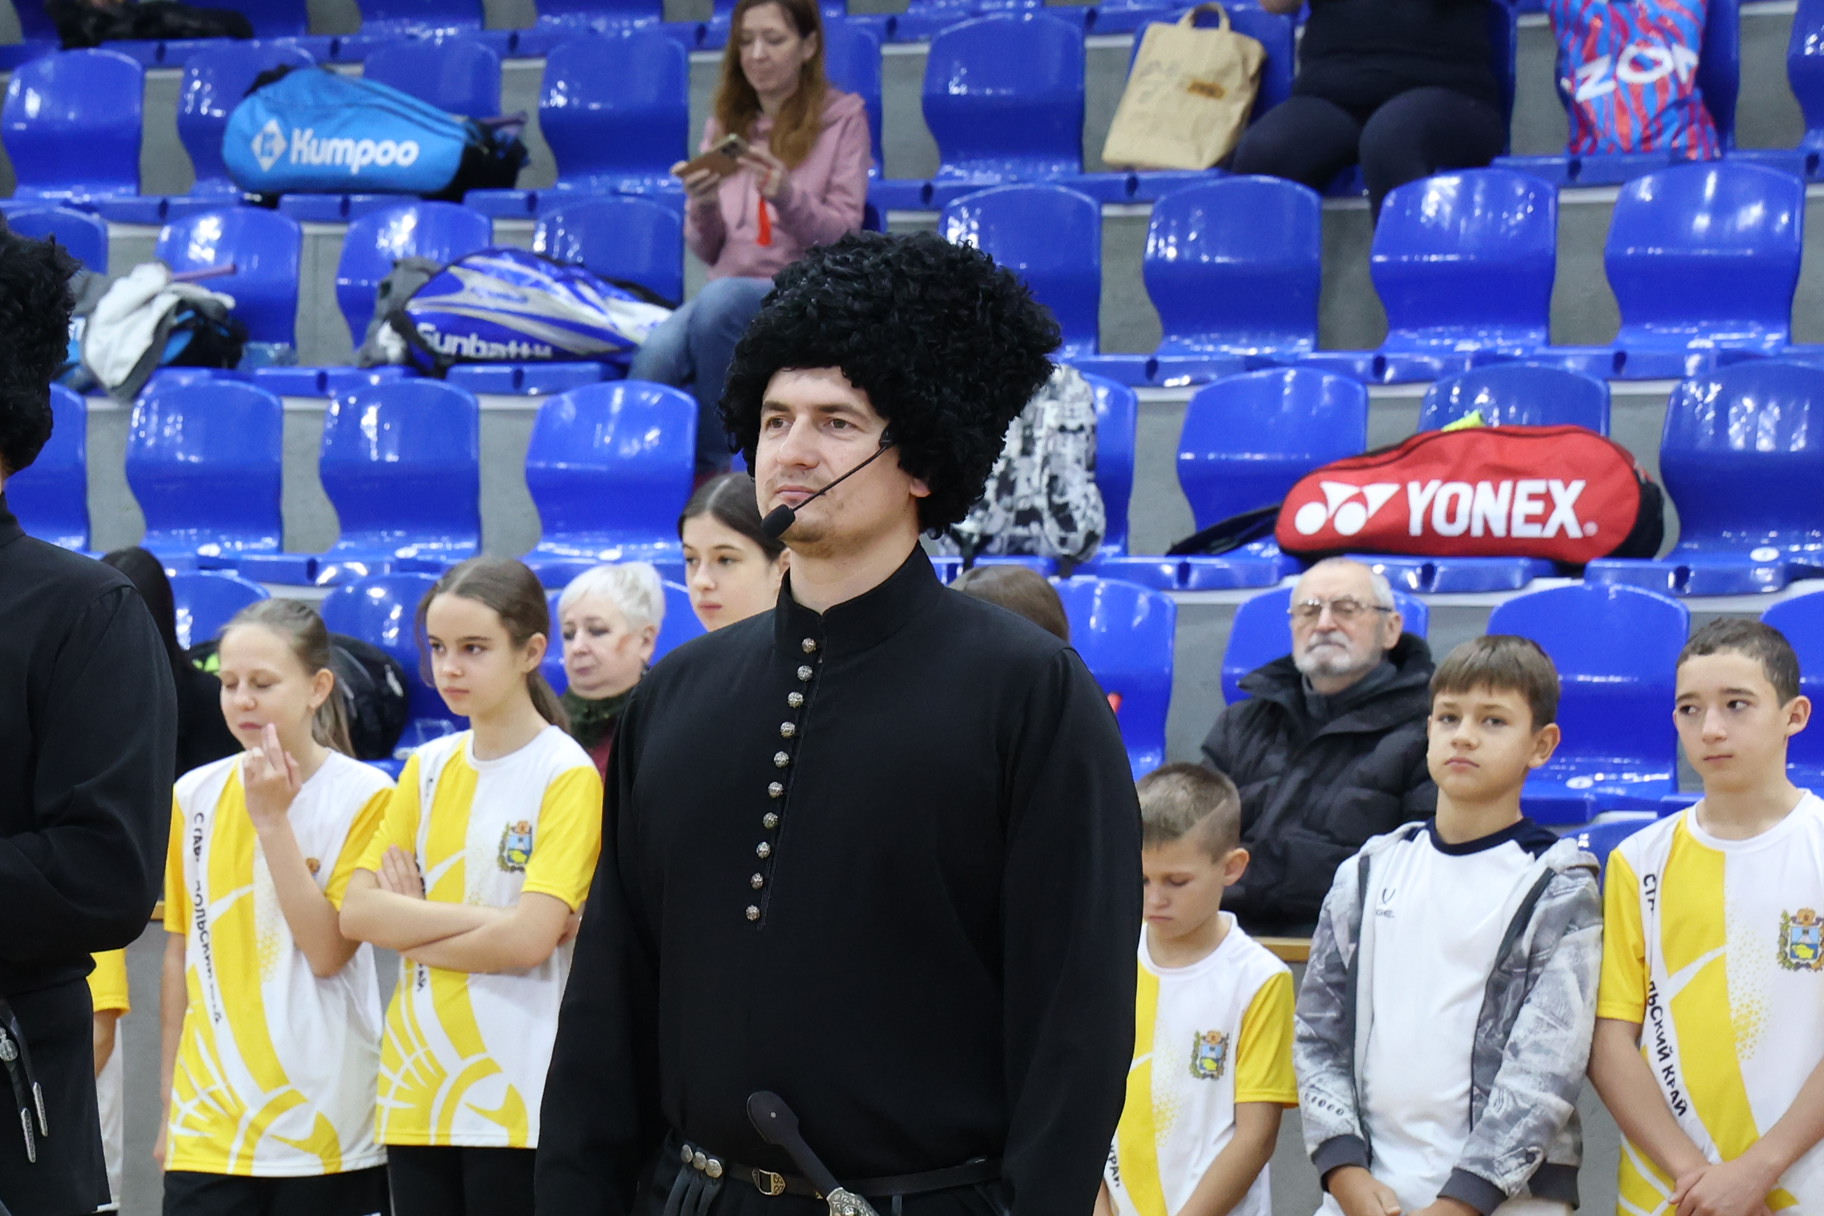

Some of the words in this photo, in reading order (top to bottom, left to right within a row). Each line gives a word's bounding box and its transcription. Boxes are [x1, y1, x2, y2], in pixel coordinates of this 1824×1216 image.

[290, 127, 420, 175] Kumpoo
[1406, 478, 1587, 539] YONEX
[1661, 1063, 1688, 1118] КРАЙ
